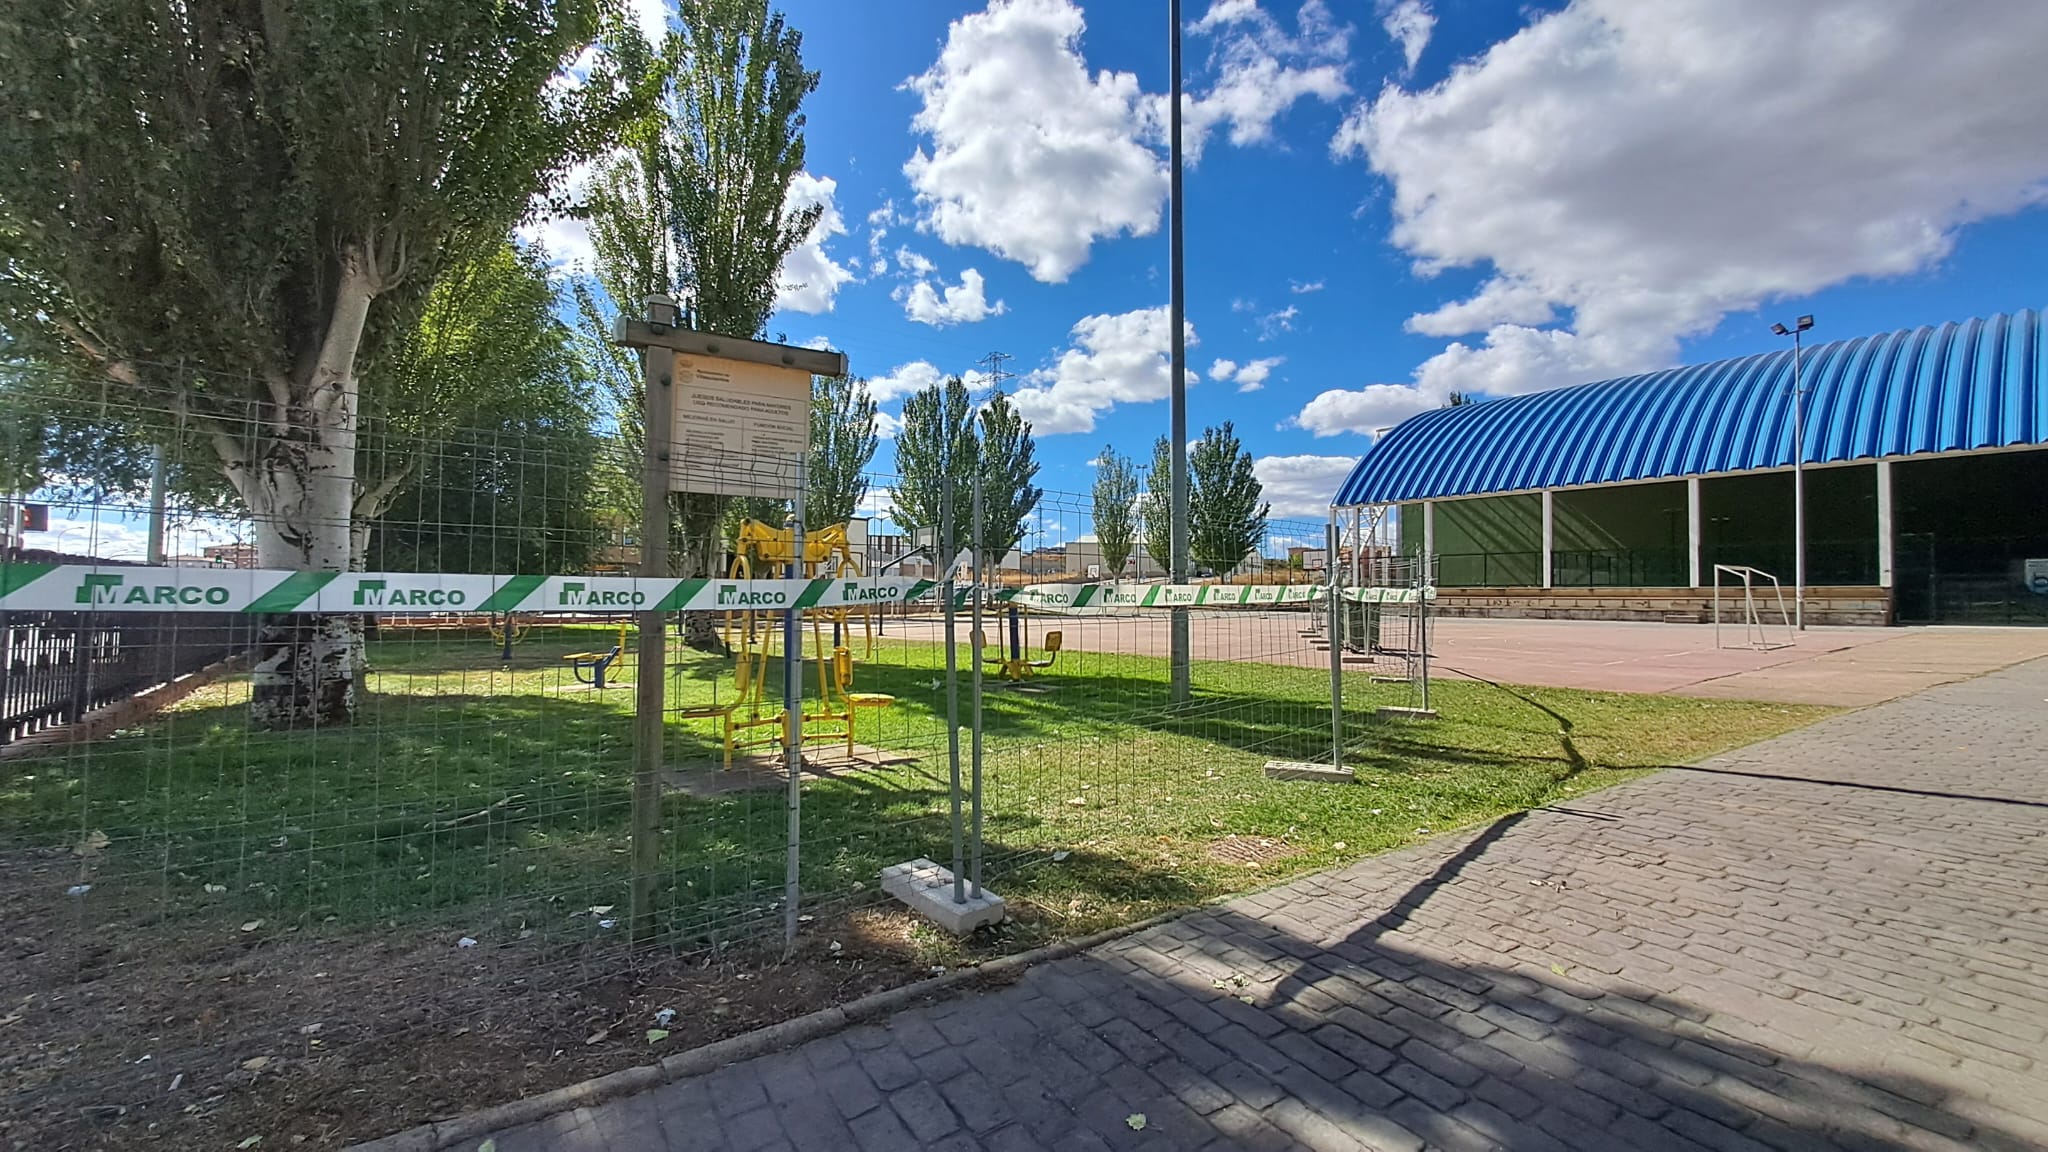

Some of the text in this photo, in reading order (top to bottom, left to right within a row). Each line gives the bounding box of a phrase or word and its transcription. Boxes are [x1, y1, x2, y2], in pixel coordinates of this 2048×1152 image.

[77, 576, 230, 605] MARCO
[355, 582, 466, 606] MARCO
[560, 584, 645, 606] MARCO
[719, 586, 786, 605] MARCO
[844, 584, 898, 601] MARCO
[1104, 589, 1136, 603] MARCO
